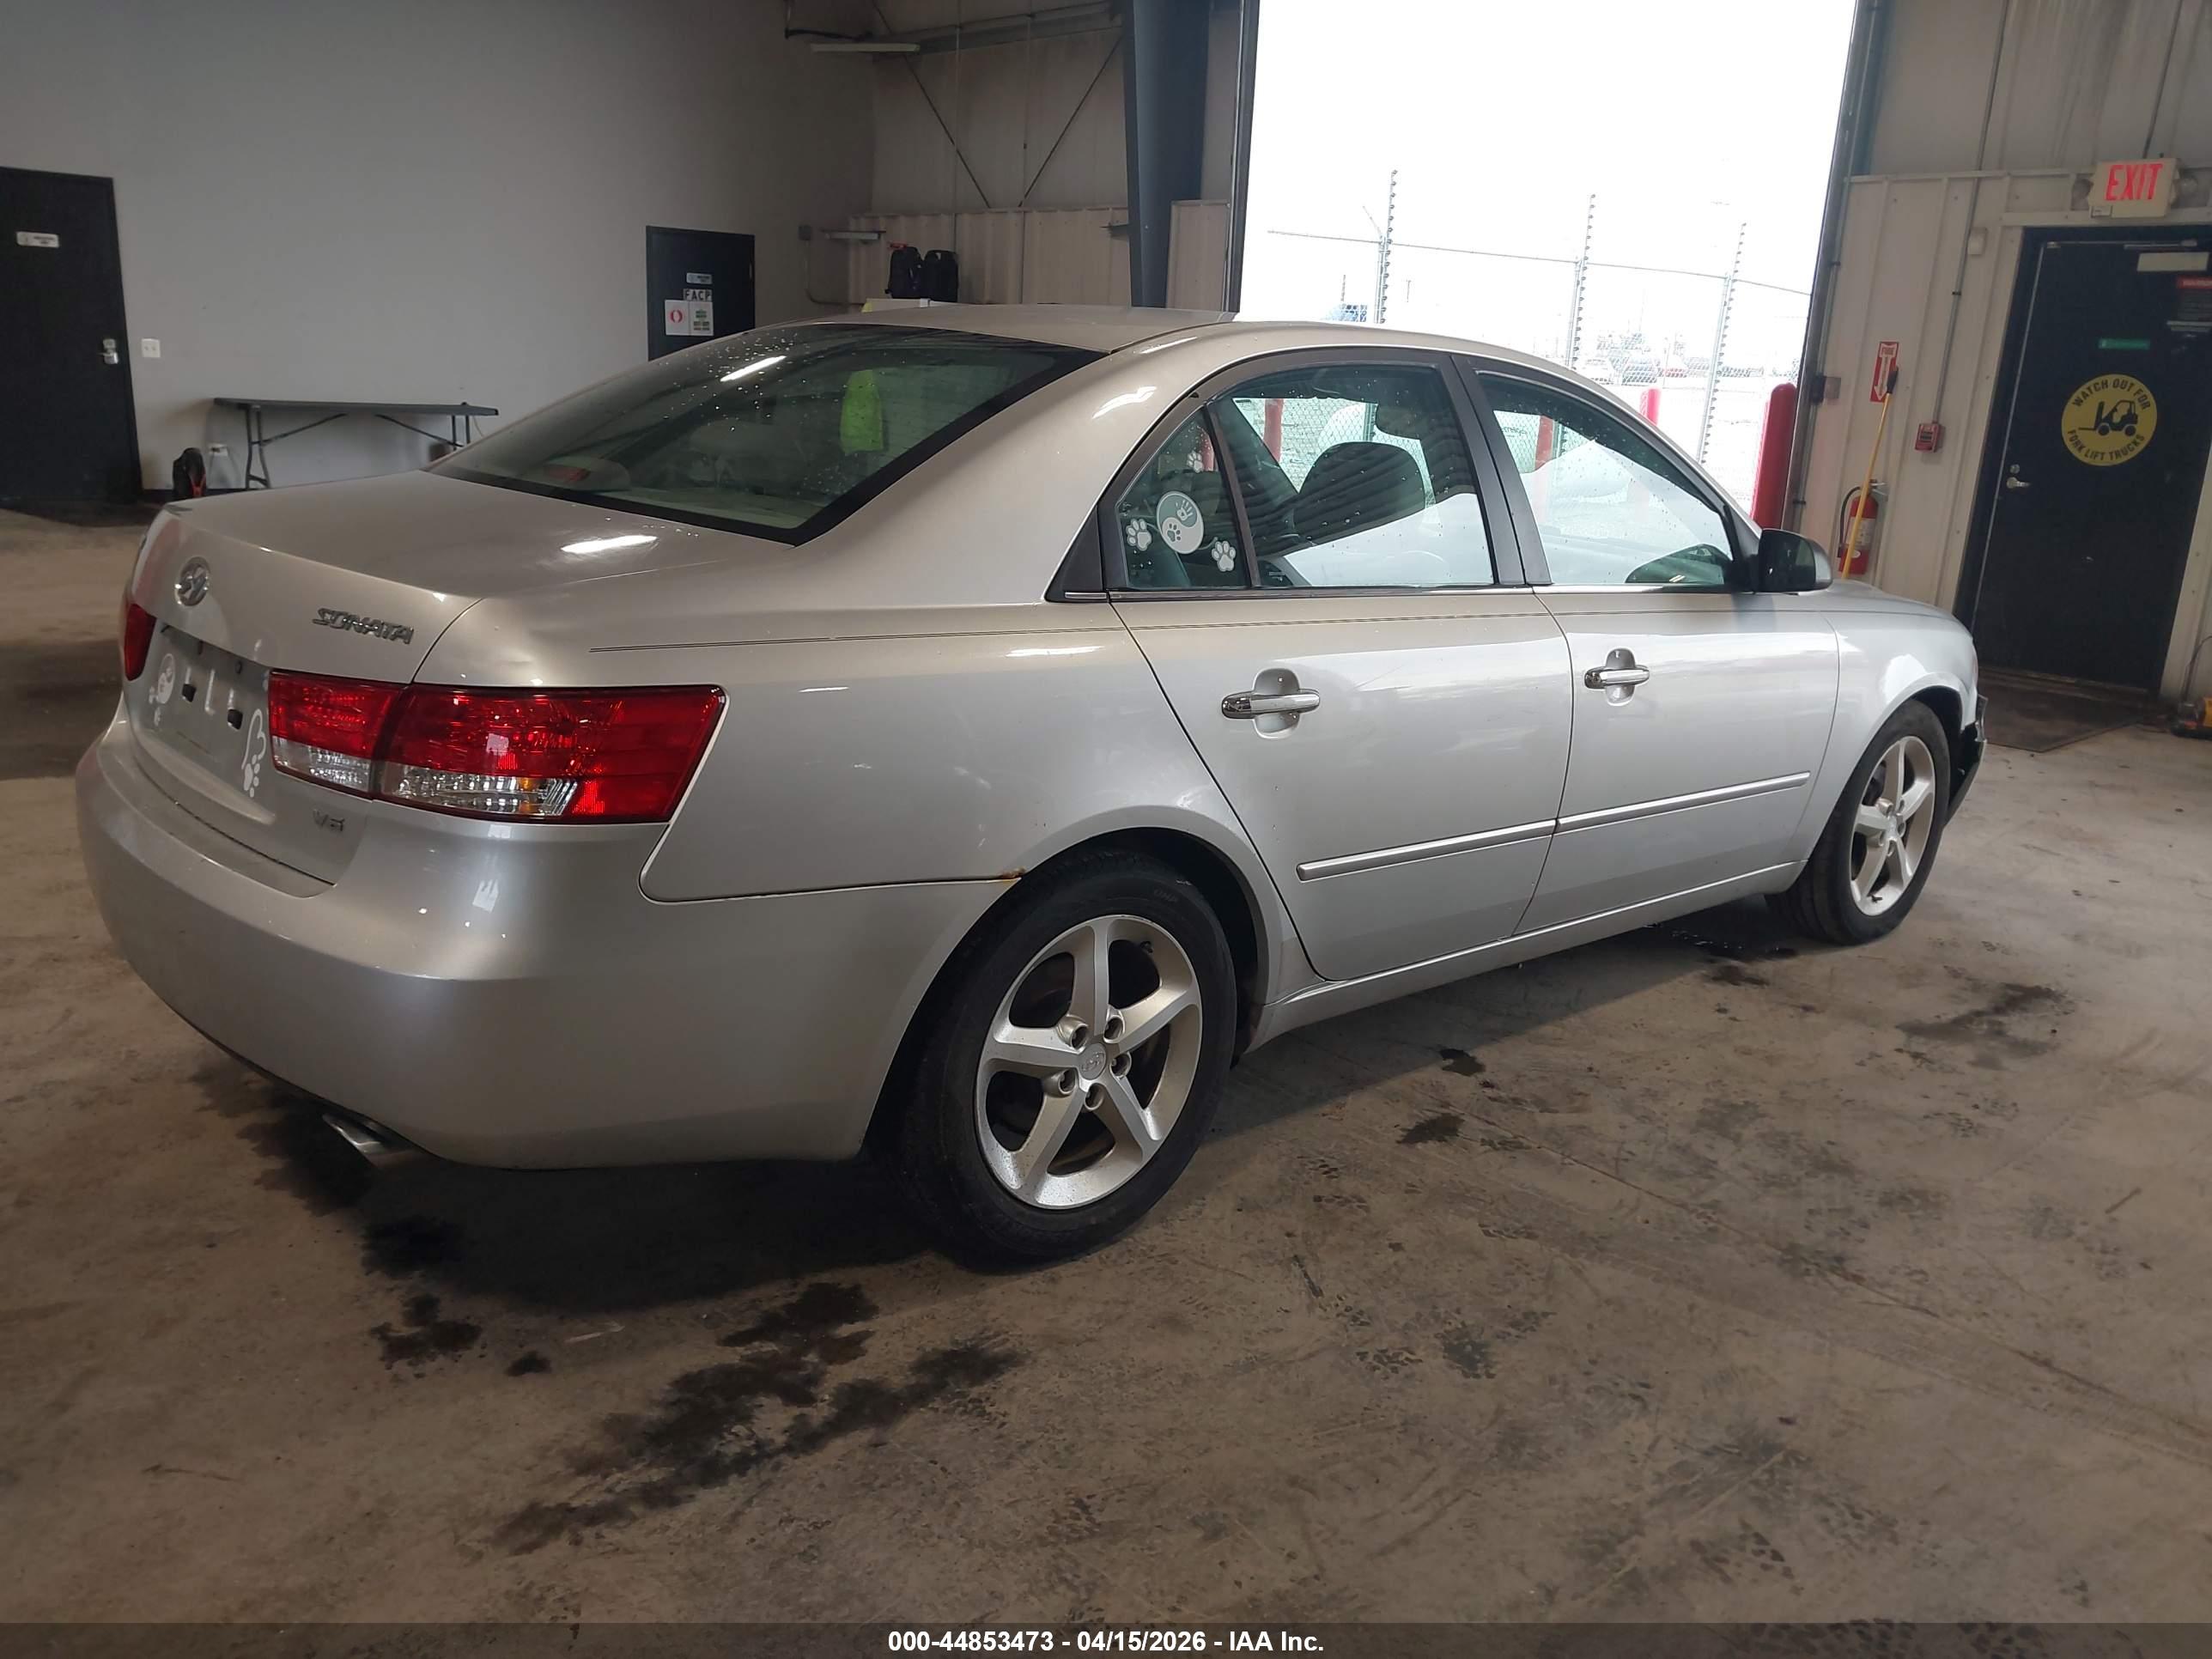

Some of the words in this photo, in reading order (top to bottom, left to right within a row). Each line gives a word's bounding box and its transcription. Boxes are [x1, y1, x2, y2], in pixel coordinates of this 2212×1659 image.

[2105, 163, 2163, 201] EXIT
[684, 289, 711, 301] FACP
[2071, 379, 2109, 407] WATCH
[2112, 378, 2135, 392] OUT
[2133, 387, 2151, 410] FOR
[2067, 429, 2086, 453] FORK
[2083, 448, 2106, 461] LIFT
[2108, 434, 2145, 460] TRUCKS
[312, 607, 414, 645] SONATA
[312, 810, 345, 832] V6
